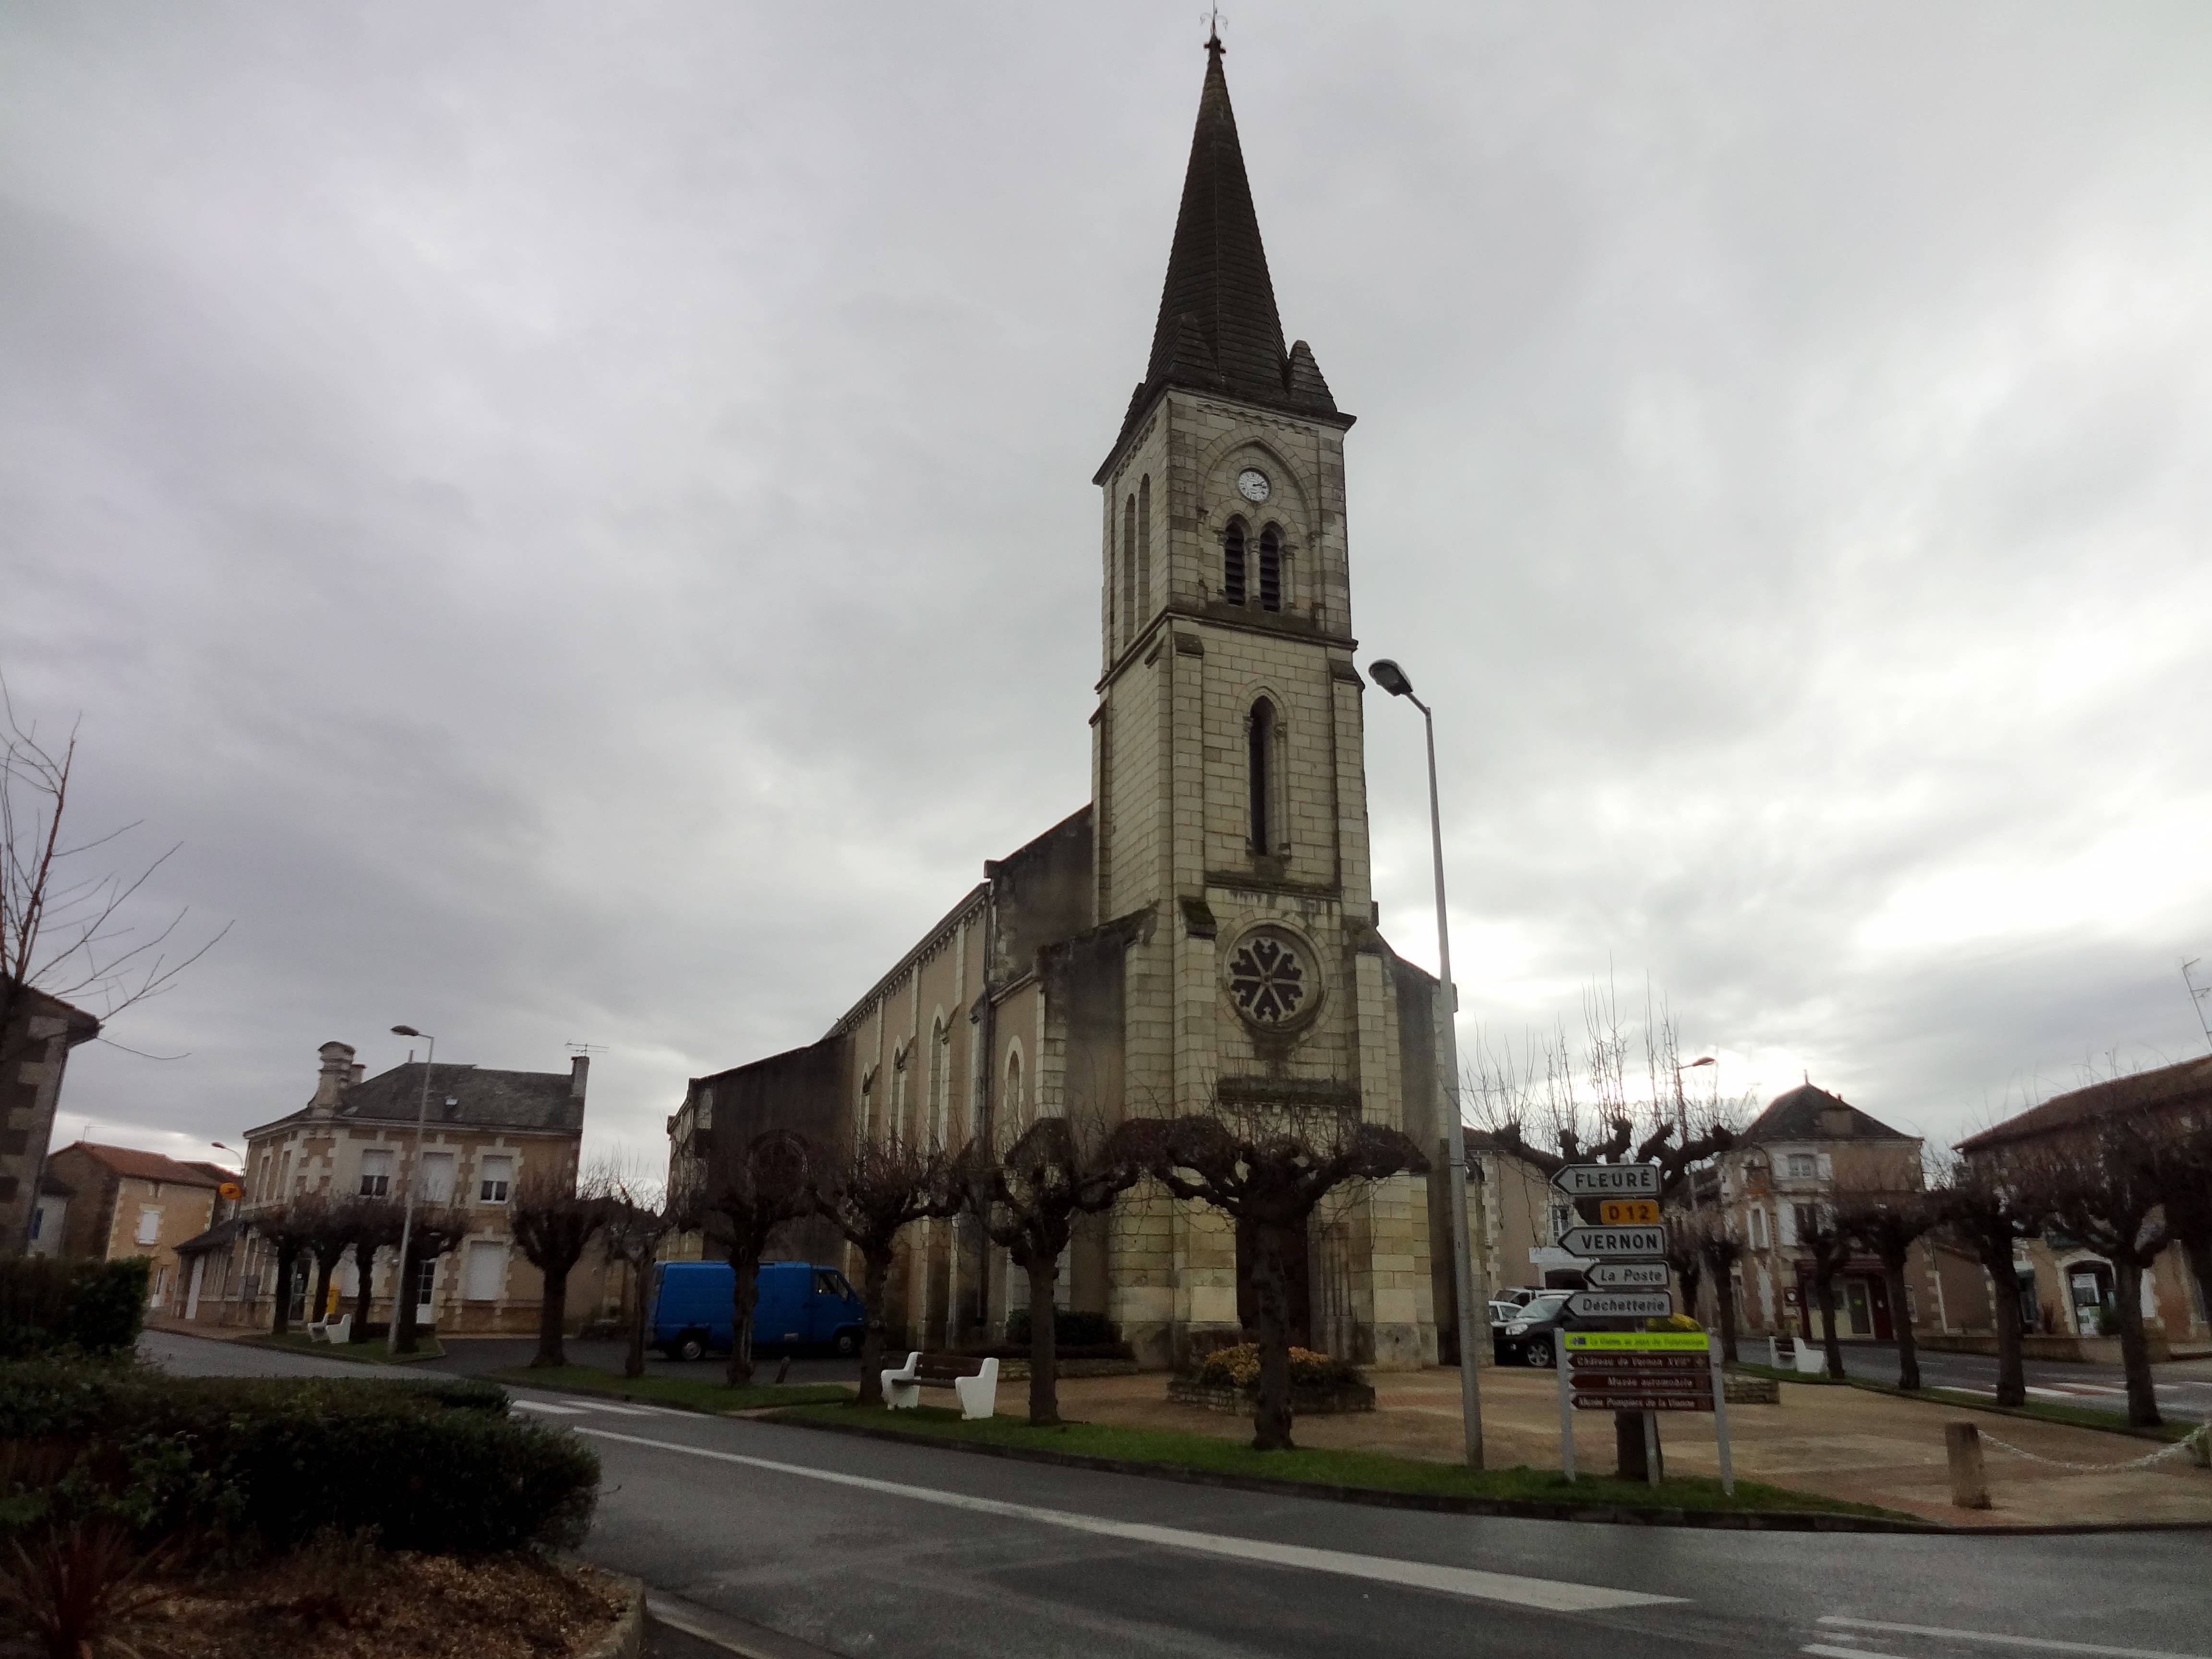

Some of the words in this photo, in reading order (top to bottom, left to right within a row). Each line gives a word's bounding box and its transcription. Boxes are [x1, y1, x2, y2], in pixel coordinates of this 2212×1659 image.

[1575, 1169, 1651, 1188] FLEURÉ
[1608, 1205, 1620, 1220] D
[1626, 1205, 1650, 1220] 12
[1581, 1233, 1657, 1250] VERNON
[1601, 1268, 1615, 1282] La
[1624, 1269, 1662, 1282] Poste
[1641, 1377, 1693, 1387] automobile
